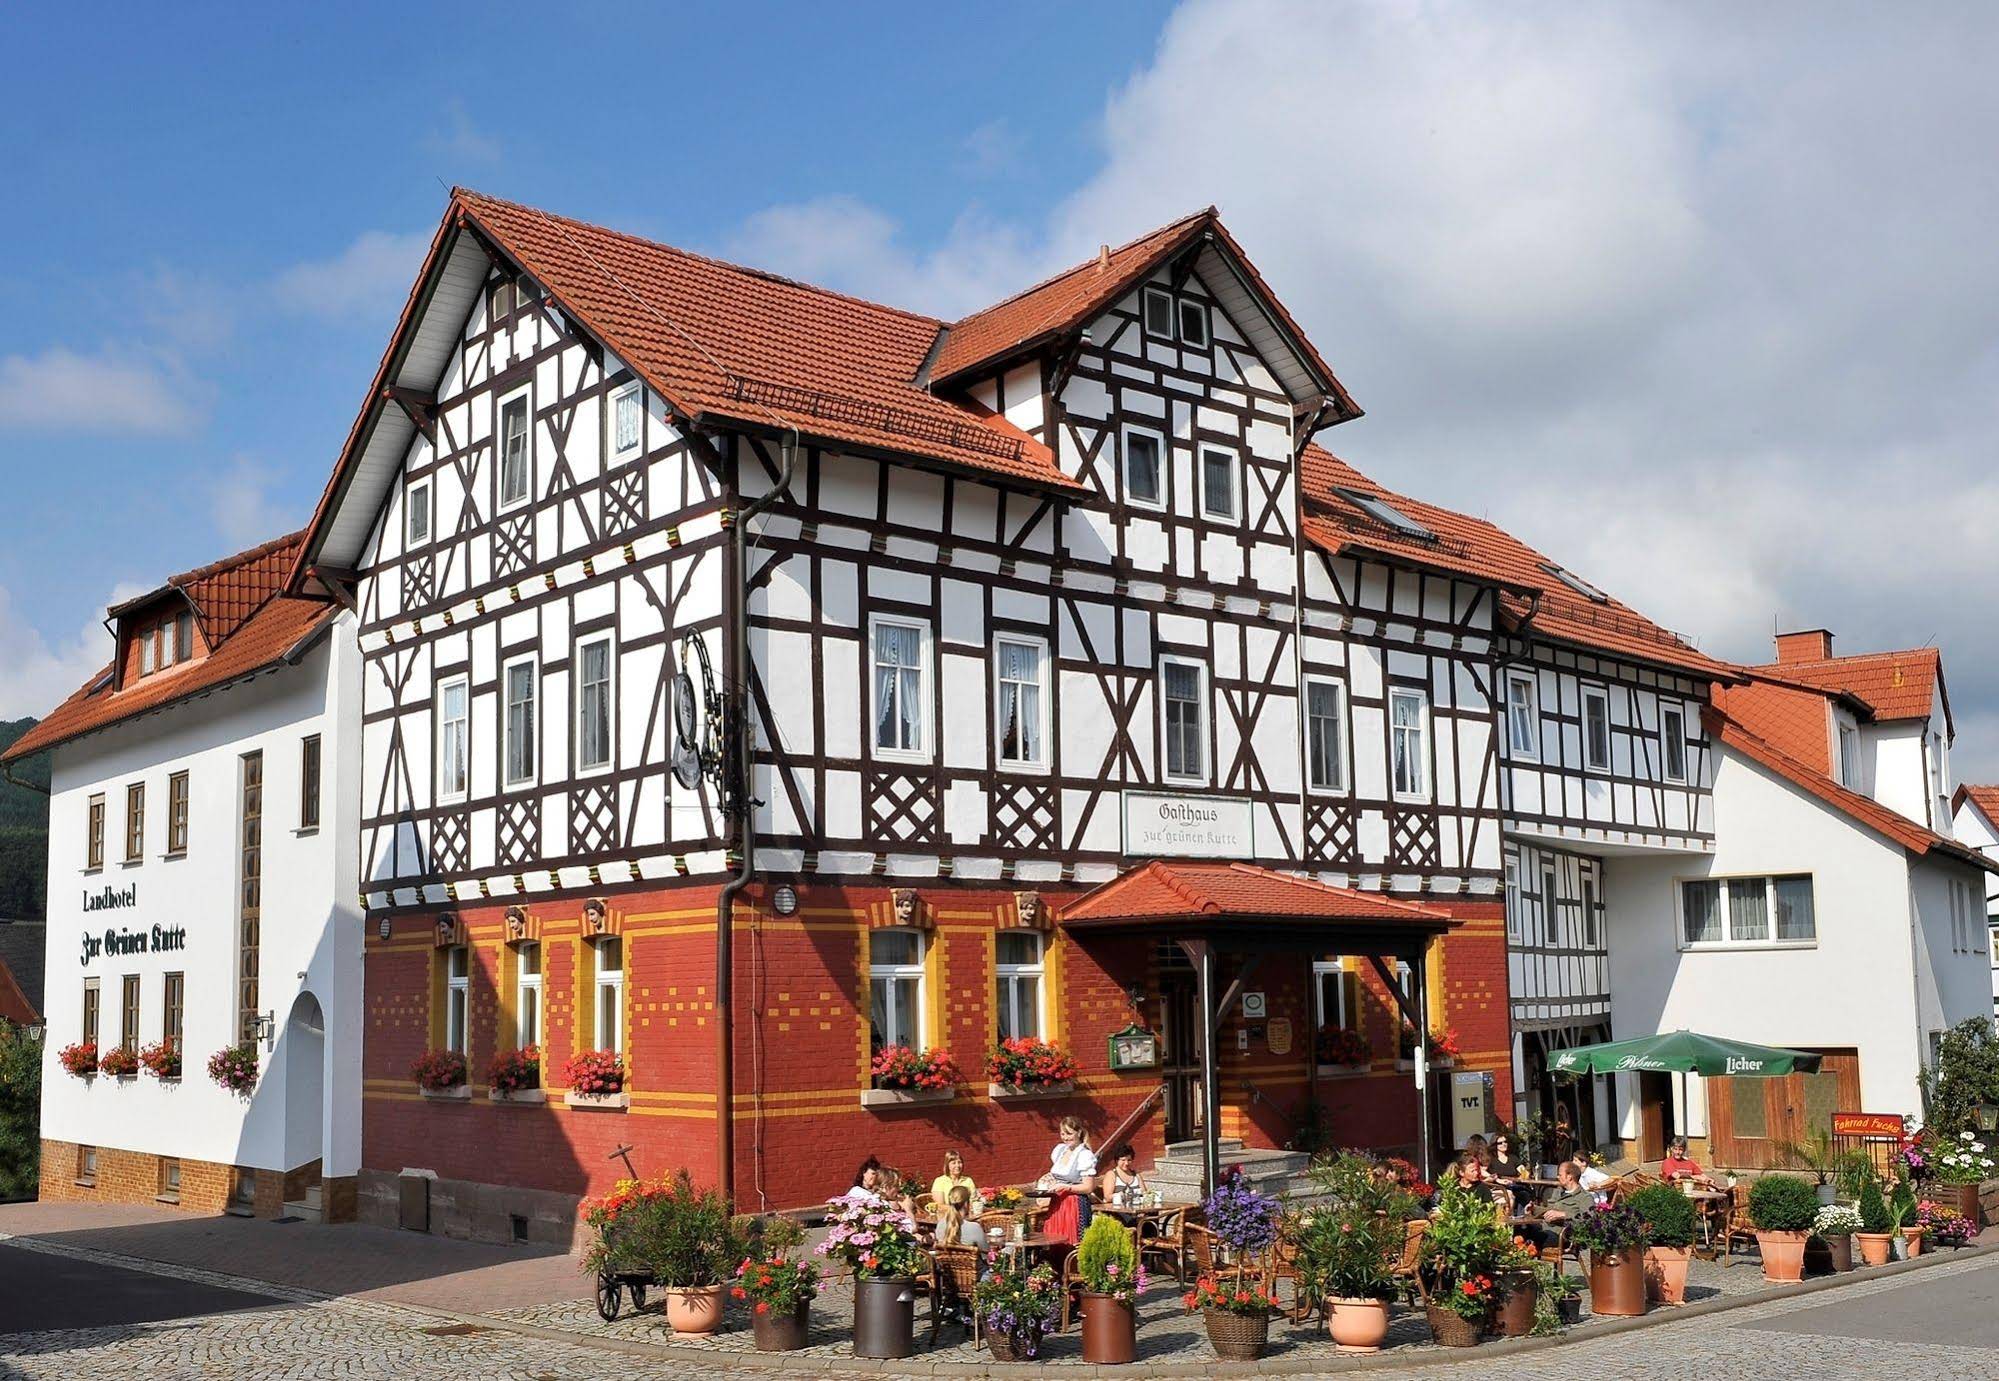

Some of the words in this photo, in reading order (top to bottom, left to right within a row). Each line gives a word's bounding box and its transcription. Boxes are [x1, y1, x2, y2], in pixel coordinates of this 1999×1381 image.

[1166, 829, 1204, 845] grünen
[1207, 831, 1237, 845] Kutte
[83, 881, 136, 912] Landhotel
[80, 931, 102, 967] Zur
[104, 927, 148, 957] Grünen
[151, 922, 186, 954] Kutte
[1616, 1054, 1666, 1069] Pilsner
[1725, 1056, 1763, 1075] Licher
[1834, 1117, 1870, 1132] Fahrrad
